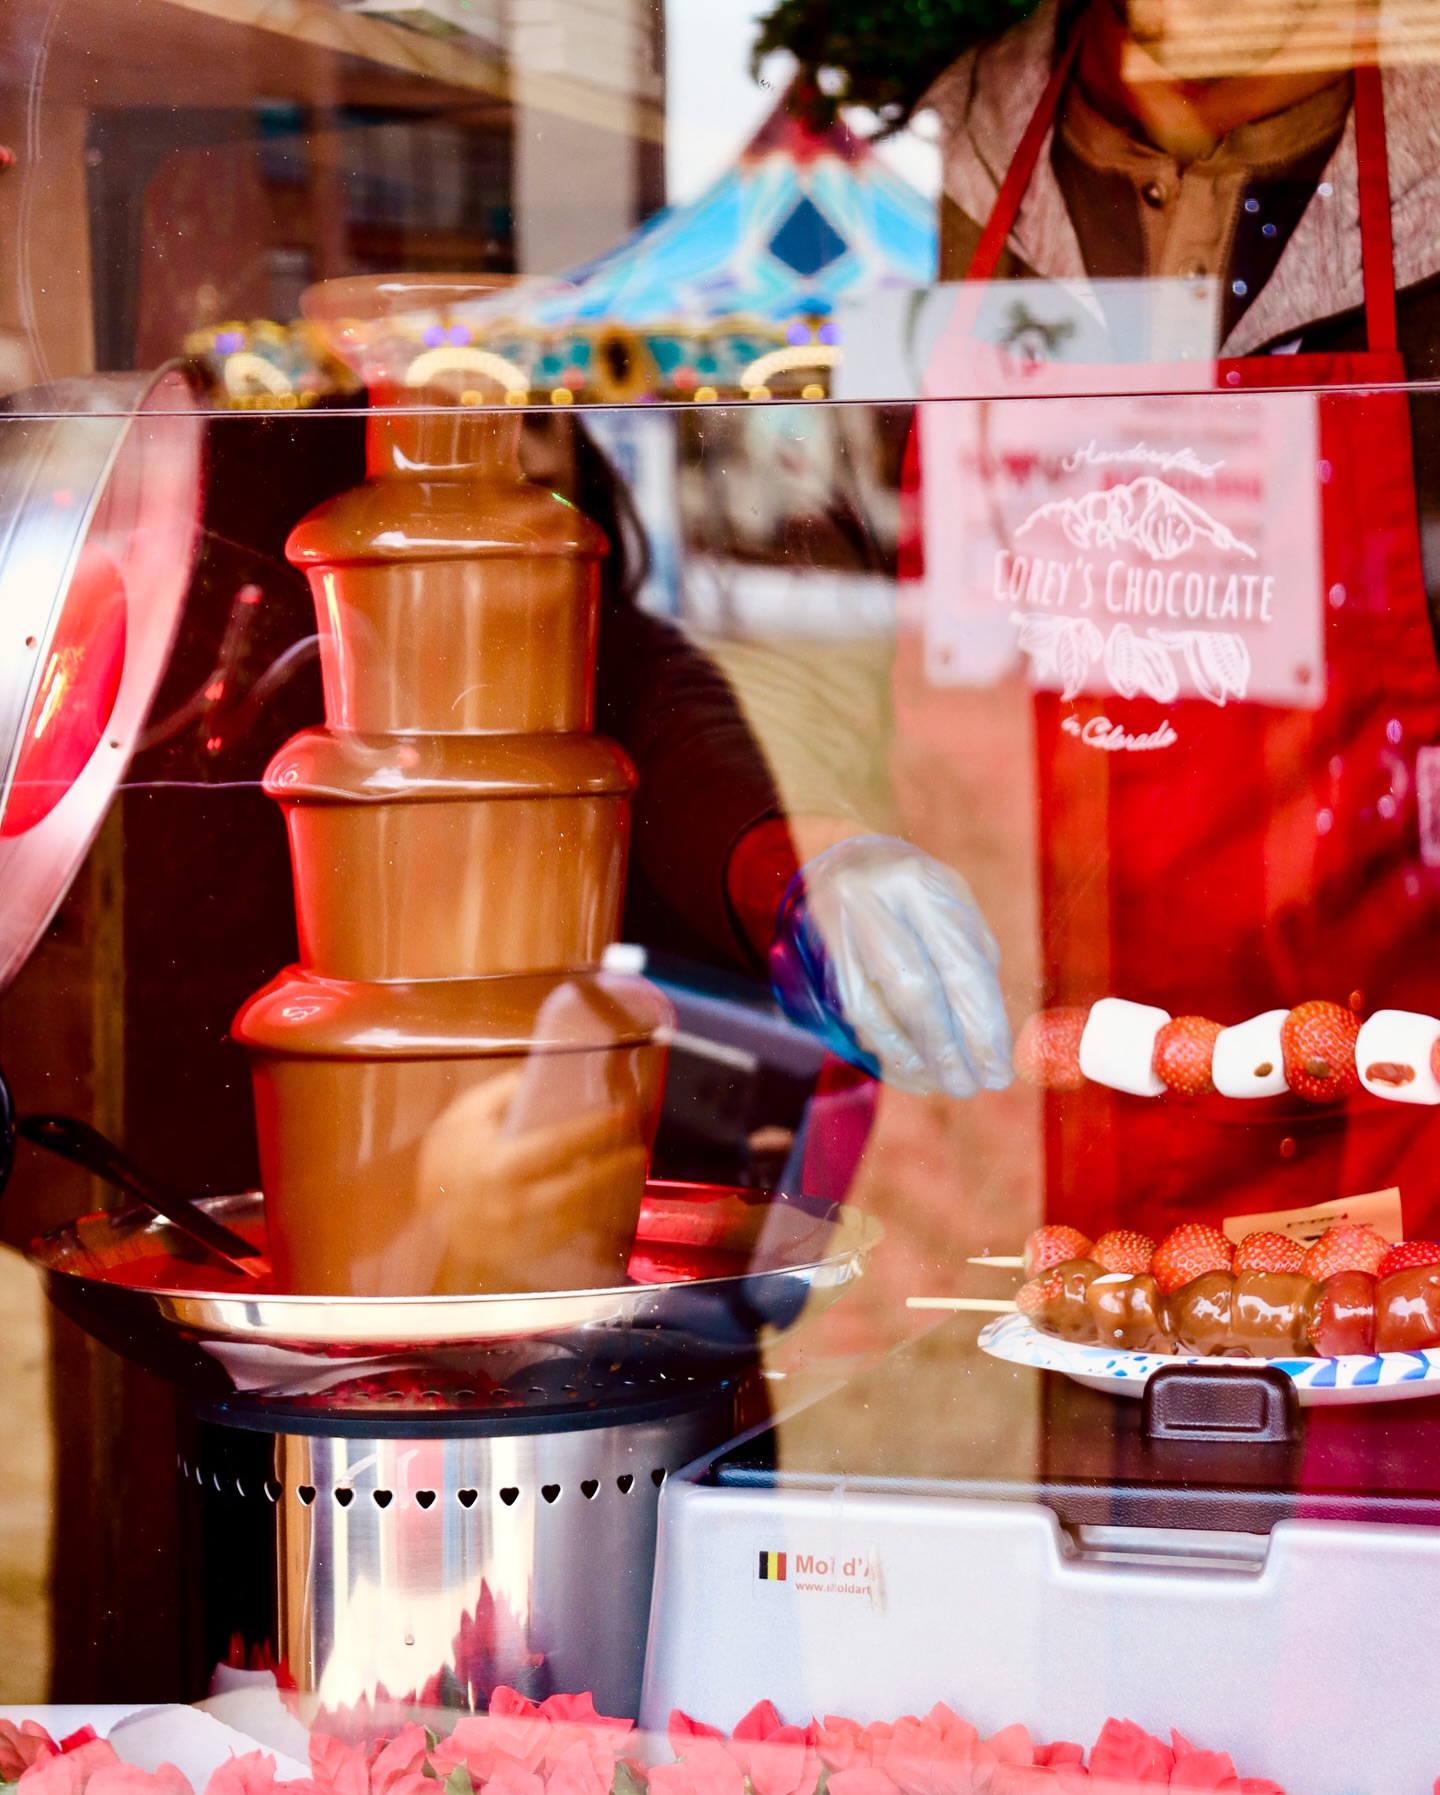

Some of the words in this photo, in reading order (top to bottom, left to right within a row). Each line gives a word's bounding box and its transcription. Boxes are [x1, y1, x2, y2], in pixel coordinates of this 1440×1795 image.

[1062, 440, 1226, 478] Handcrafted
[995, 550, 1093, 609] COREY'S
[1106, 563, 1274, 622] CHOCOLATE
[1061, 713, 1081, 736] in
[1082, 716, 1178, 751] Colorado
